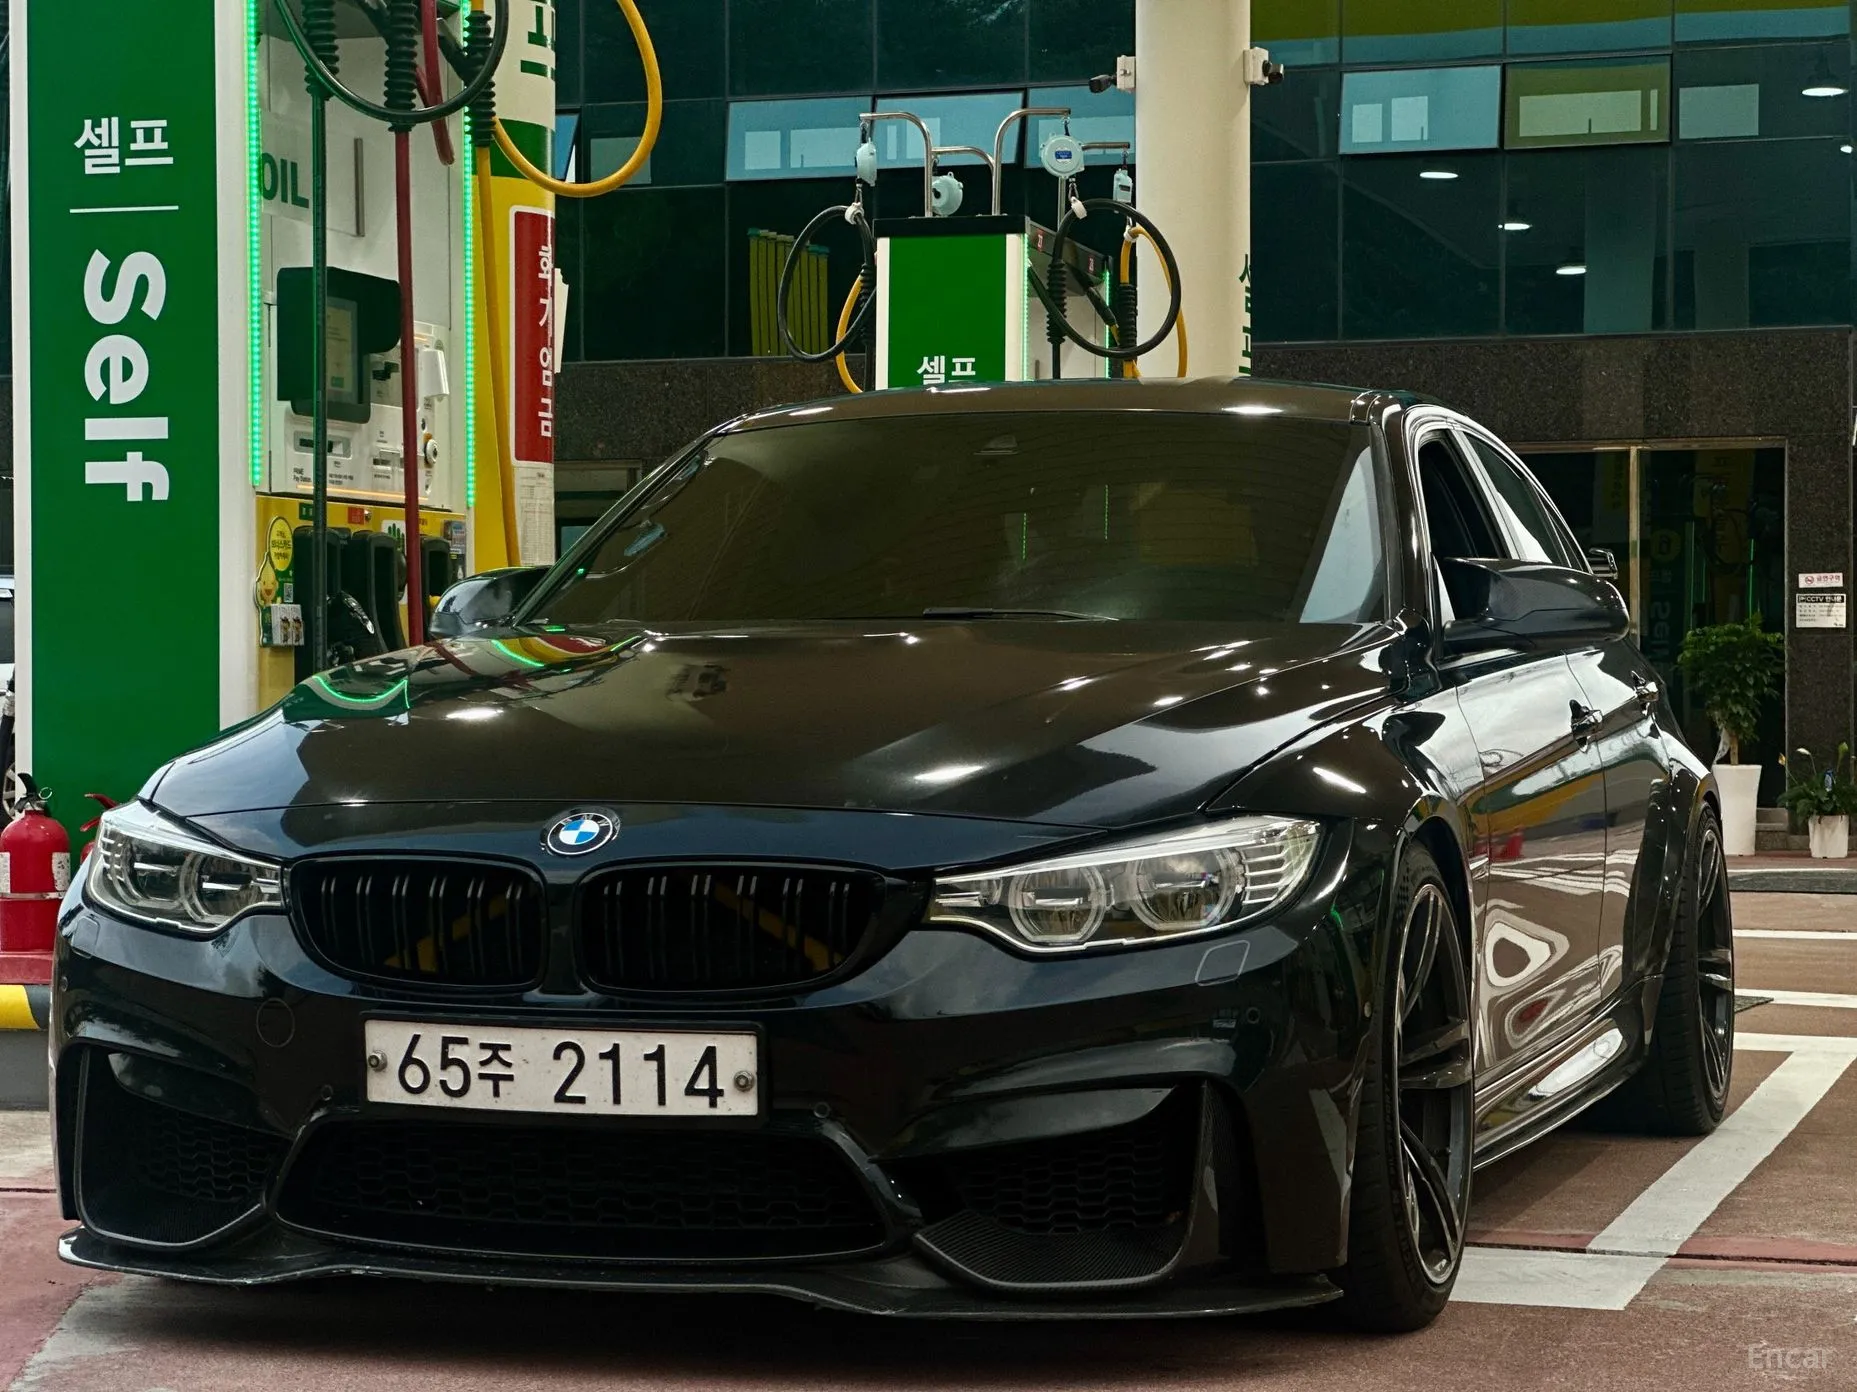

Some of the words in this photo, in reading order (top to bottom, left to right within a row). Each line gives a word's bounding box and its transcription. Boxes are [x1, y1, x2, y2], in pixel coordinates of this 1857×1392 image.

[74, 116, 174, 174] 셀프
[259, 152, 310, 209] OIL
[83, 248, 170, 502] Self
[916, 354, 977, 386] 셀프
[398, 1033, 515, 1098] 65주
[552, 1041, 726, 1109] 2114
